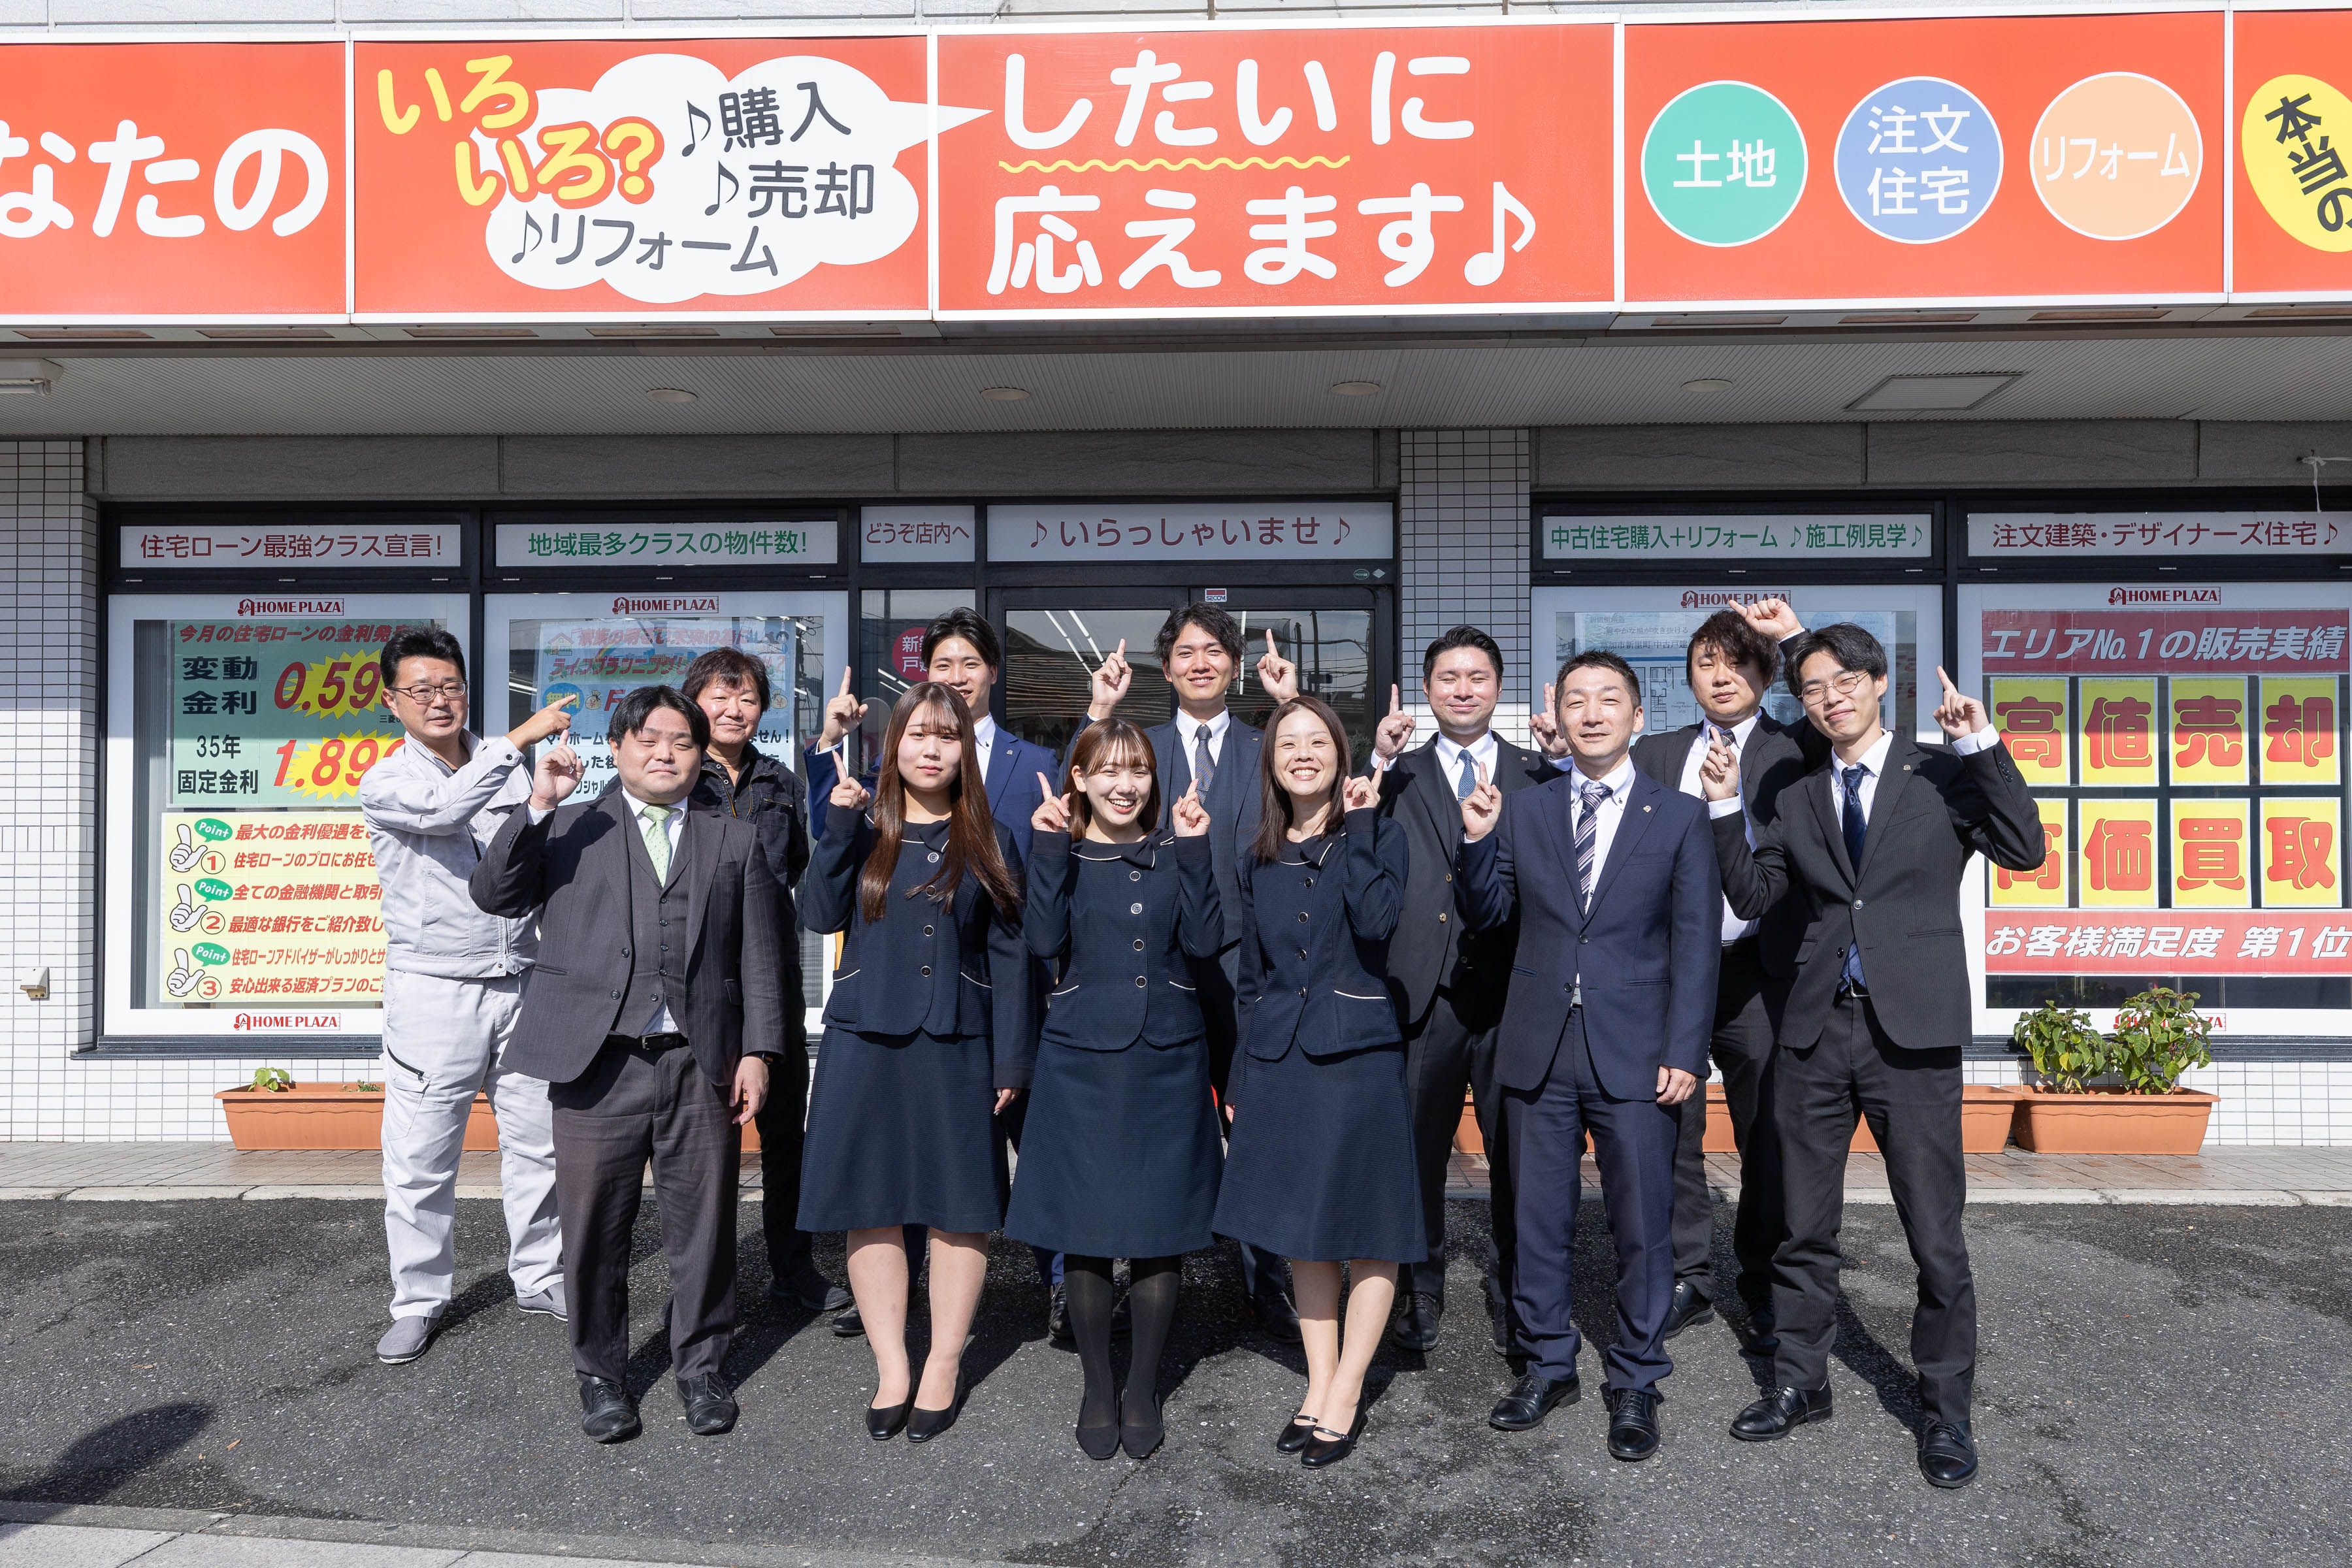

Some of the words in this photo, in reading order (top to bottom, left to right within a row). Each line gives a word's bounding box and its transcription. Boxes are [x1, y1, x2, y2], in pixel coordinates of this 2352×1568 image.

[378, 55, 529, 134] いろ
[1004, 50, 1475, 150] したいに
[718, 82, 852, 153] 購入
[1867, 103, 1971, 156] 注文
[455, 122, 656, 206] いろ?
[1673, 139, 1777, 189] 土地
[2042, 133, 2191, 182] リフォーム
[0, 120, 329, 238] なたの
[747, 161, 874, 220] 売却
[1867, 165, 1970, 216] 住宅
[551, 212, 777, 276] リフォーム
[987, 182, 1465, 295] 応えます
[528, 531, 808, 557] 地域最多クラスの物件数!
[865, 522, 970, 545] どうぞ店内へ
[1060, 516, 1321, 547] いらっしゃいませ
[1806, 523, 1907, 549] 施工例見学
[1993, 521, 2317, 548] 注文建築・デザイナーズ住宅
[140, 534, 442, 559] 住宅ローン最強クラス宣言!
[256, 601, 297, 614] HOME
[299, 601, 342, 614] PLAZA
[631, 599, 671, 612] HOME
[674, 599, 716, 612] PLAZA
[1701, 593, 1741, 605] HOME
[2129, 590, 2170, 602] HOME
[2172, 590, 2218, 602] PLAZA
[182, 656, 257, 681] 変動
[274, 661, 389, 711] 0.59
[182, 691, 257, 715] 金利
[1996, 694, 2334, 769] 高値売却
[196, 734, 241, 759] 35年
[274, 739, 406, 789] 1.89
[178, 769, 259, 794] 固定金利
[198, 821, 229, 838] Point
[198, 881, 230, 898] Point
[233, 884, 384, 900] 全ての金融機関と取引
[228, 915, 384, 933] 最適な銀行をご紹介致し
[195, 945, 227, 963] Point
[1985, 925, 2226, 958] お客様満足度
[2237, 925, 2352, 959] 第1位
[229, 975, 384, 994] 安心出来る返済プランのご
[253, 1016, 293, 1027] HOME
[295, 1016, 337, 1027] PLAZA
